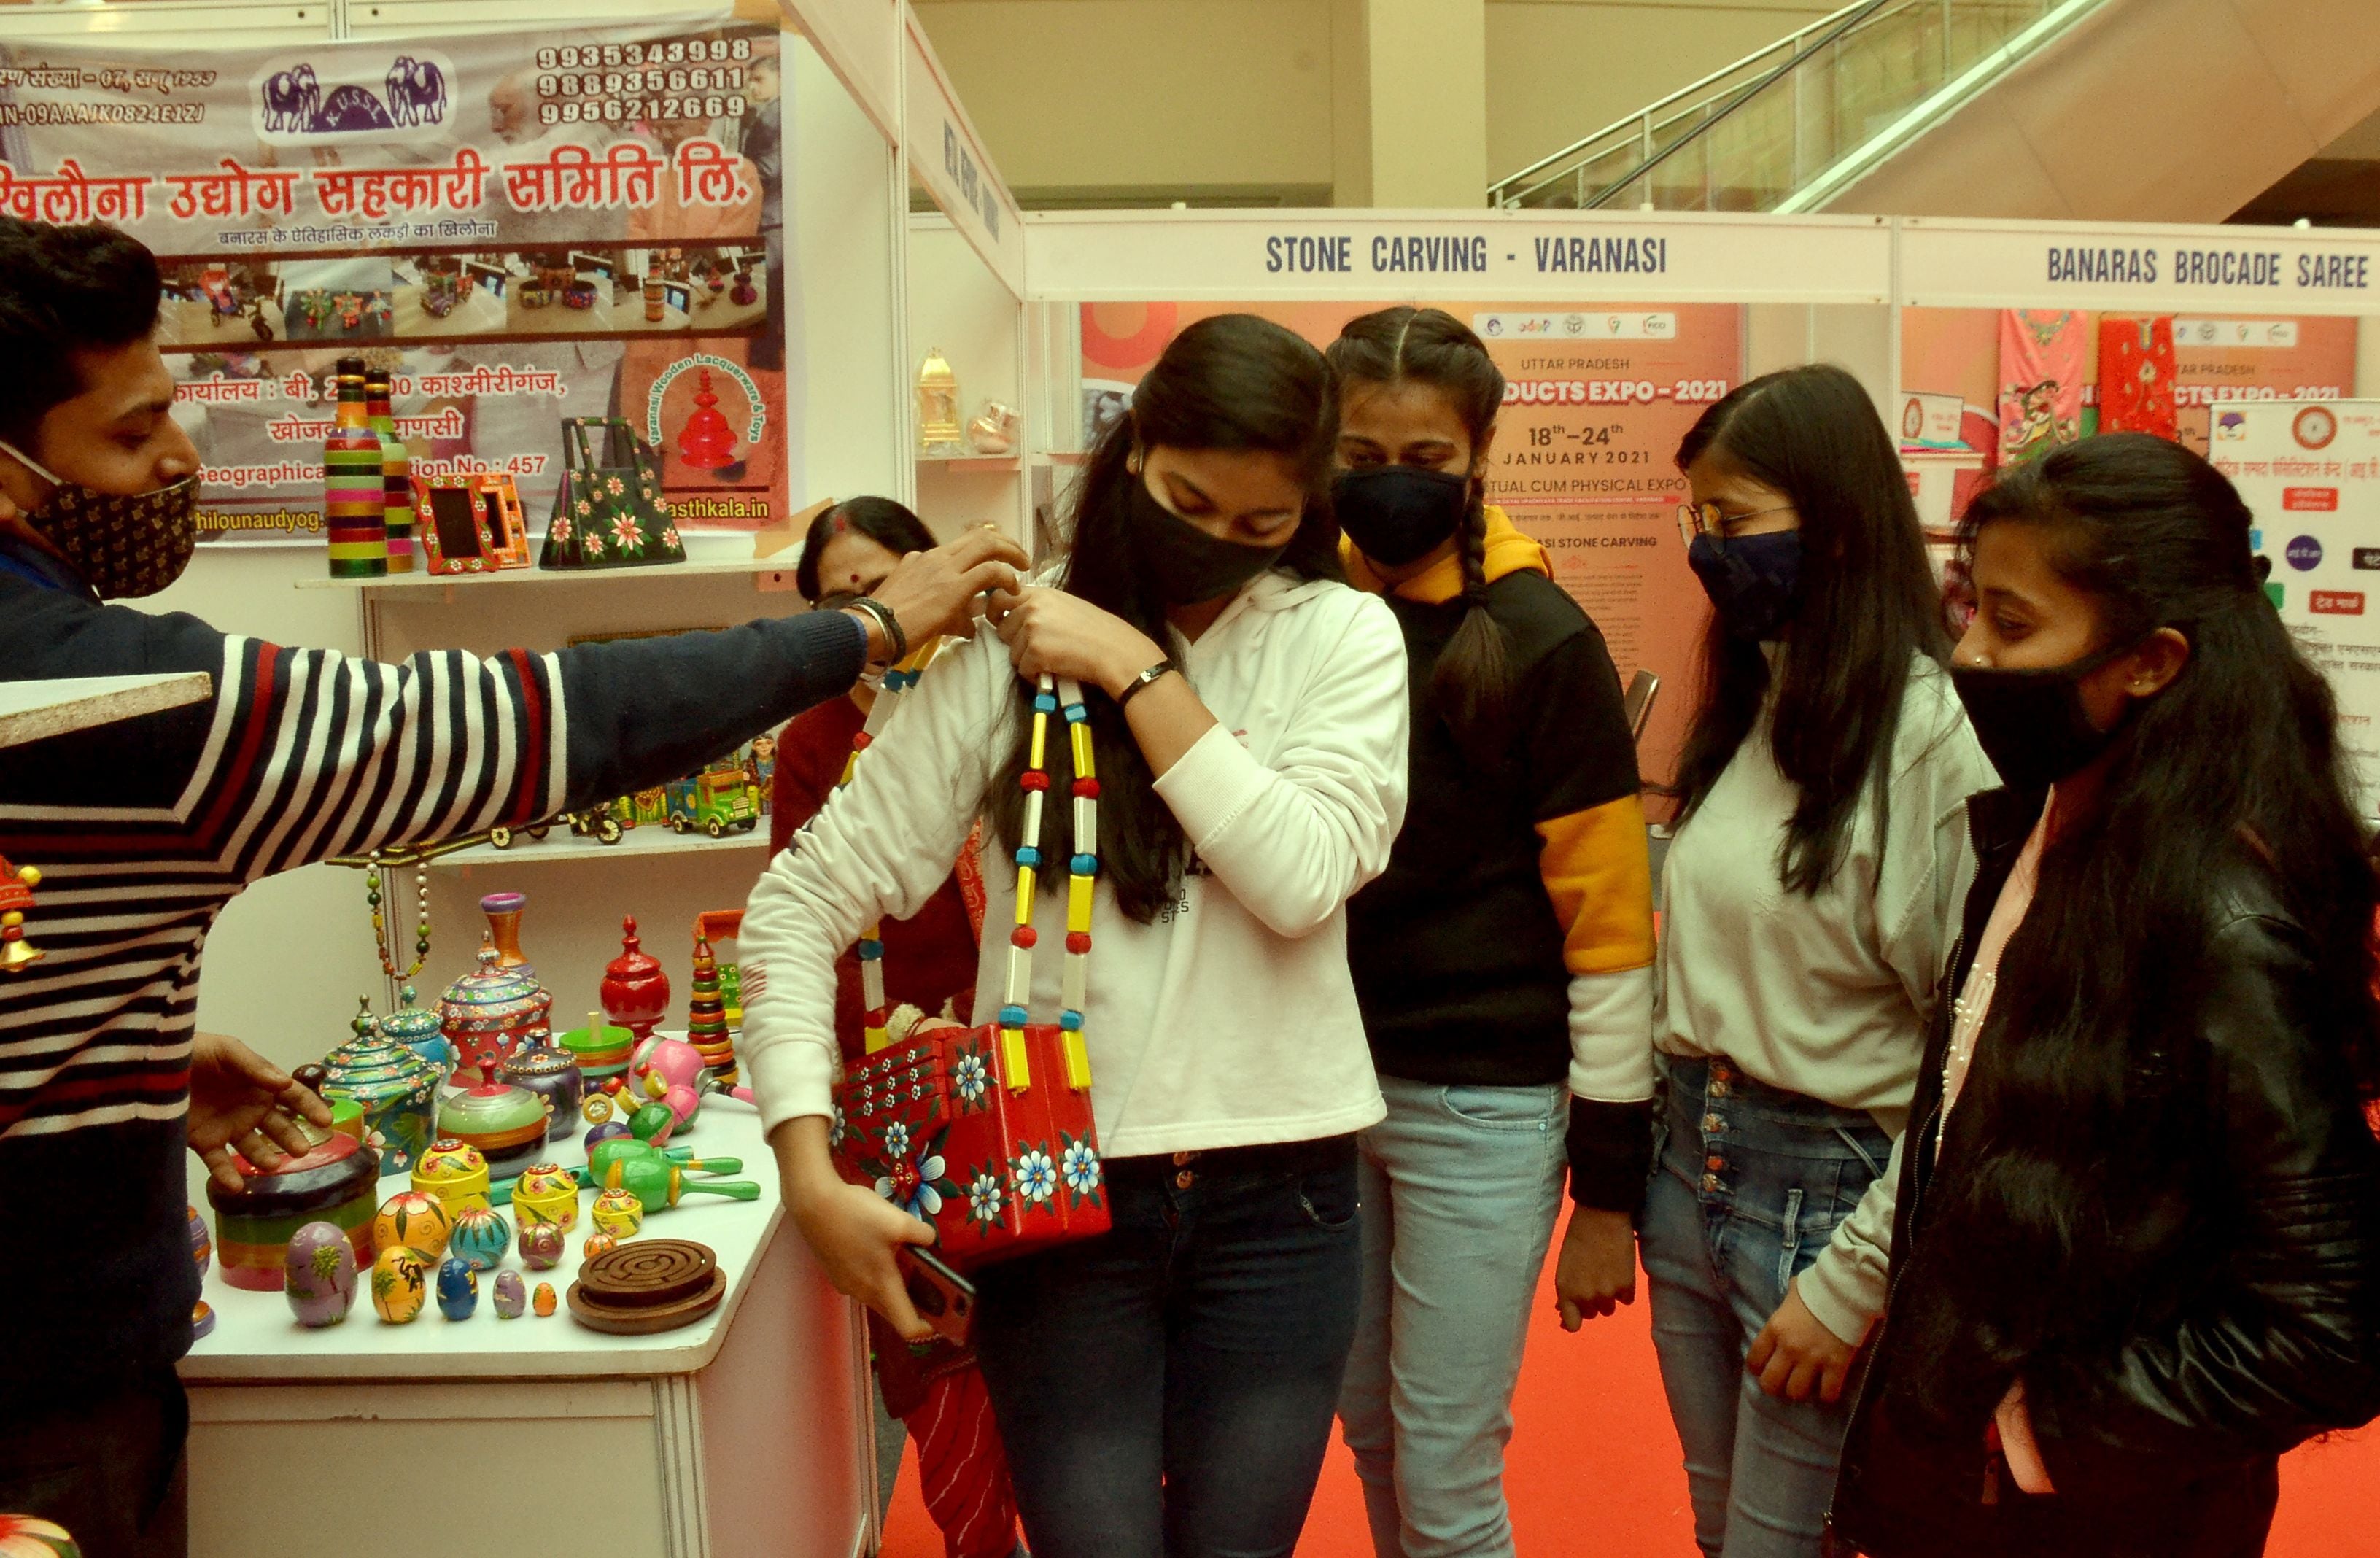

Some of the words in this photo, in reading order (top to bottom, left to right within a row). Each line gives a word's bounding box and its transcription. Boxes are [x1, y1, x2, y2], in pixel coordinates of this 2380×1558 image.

[537, 39, 751, 69] 9935343998
[537, 67, 744, 97] 9889356611
[539, 95, 747, 125] 9956212669
[167, 158, 300, 218] उद्योग
[314, 148, 489, 217] सहकारी
[504, 144, 663, 208] समिति
[678, 141, 750, 205] लि.
[220, 231, 268, 245] बनारस
[273, 228, 287, 243] के
[292, 225, 364, 244] ऐतिहासिक
[414, 224, 433, 238] का
[438, 219, 497, 237] खिलौना
[1266, 236, 1352, 272] STONE
[1372, 236, 1487, 272] CARVING
[1535, 237, 1667, 273] VARANASI
[2047, 247, 2158, 283] BANARAS
[2176, 251, 2281, 286] BROCADE
[2298, 255, 2369, 289] SAREE
[653, 358, 692, 394] Wooden
[1521, 358, 1564, 370] UTTAR
[1569, 357, 1630, 370] PRADESH
[695, 354, 759, 402] Lacquerware
[1503, 381, 1586, 401] DUCTS
[1589, 380, 1654, 401] EXPO
[1675, 379, 1727, 401] 2021
[651, 396, 661, 444] Varanasi
[750, 416, 764, 443] Toys
[508, 456, 545, 473] 457
[1503, 451, 1597, 465] JANUARY
[1606, 451, 1649, 464] 2021
[198, 462, 326, 487] Geographica
[1489, 480, 1526, 492] TUAL
[1532, 480, 1566, 492] CUM
[1572, 478, 1643, 492] PHYSICAL
[1648, 478, 1686, 491] EXPO
[195, 508, 325, 532] hilounaudyog.
[667, 497, 769, 519] asthkala.in
[1559, 538, 1597, 549] STONE
[1600, 537, 1657, 548] CARVING
